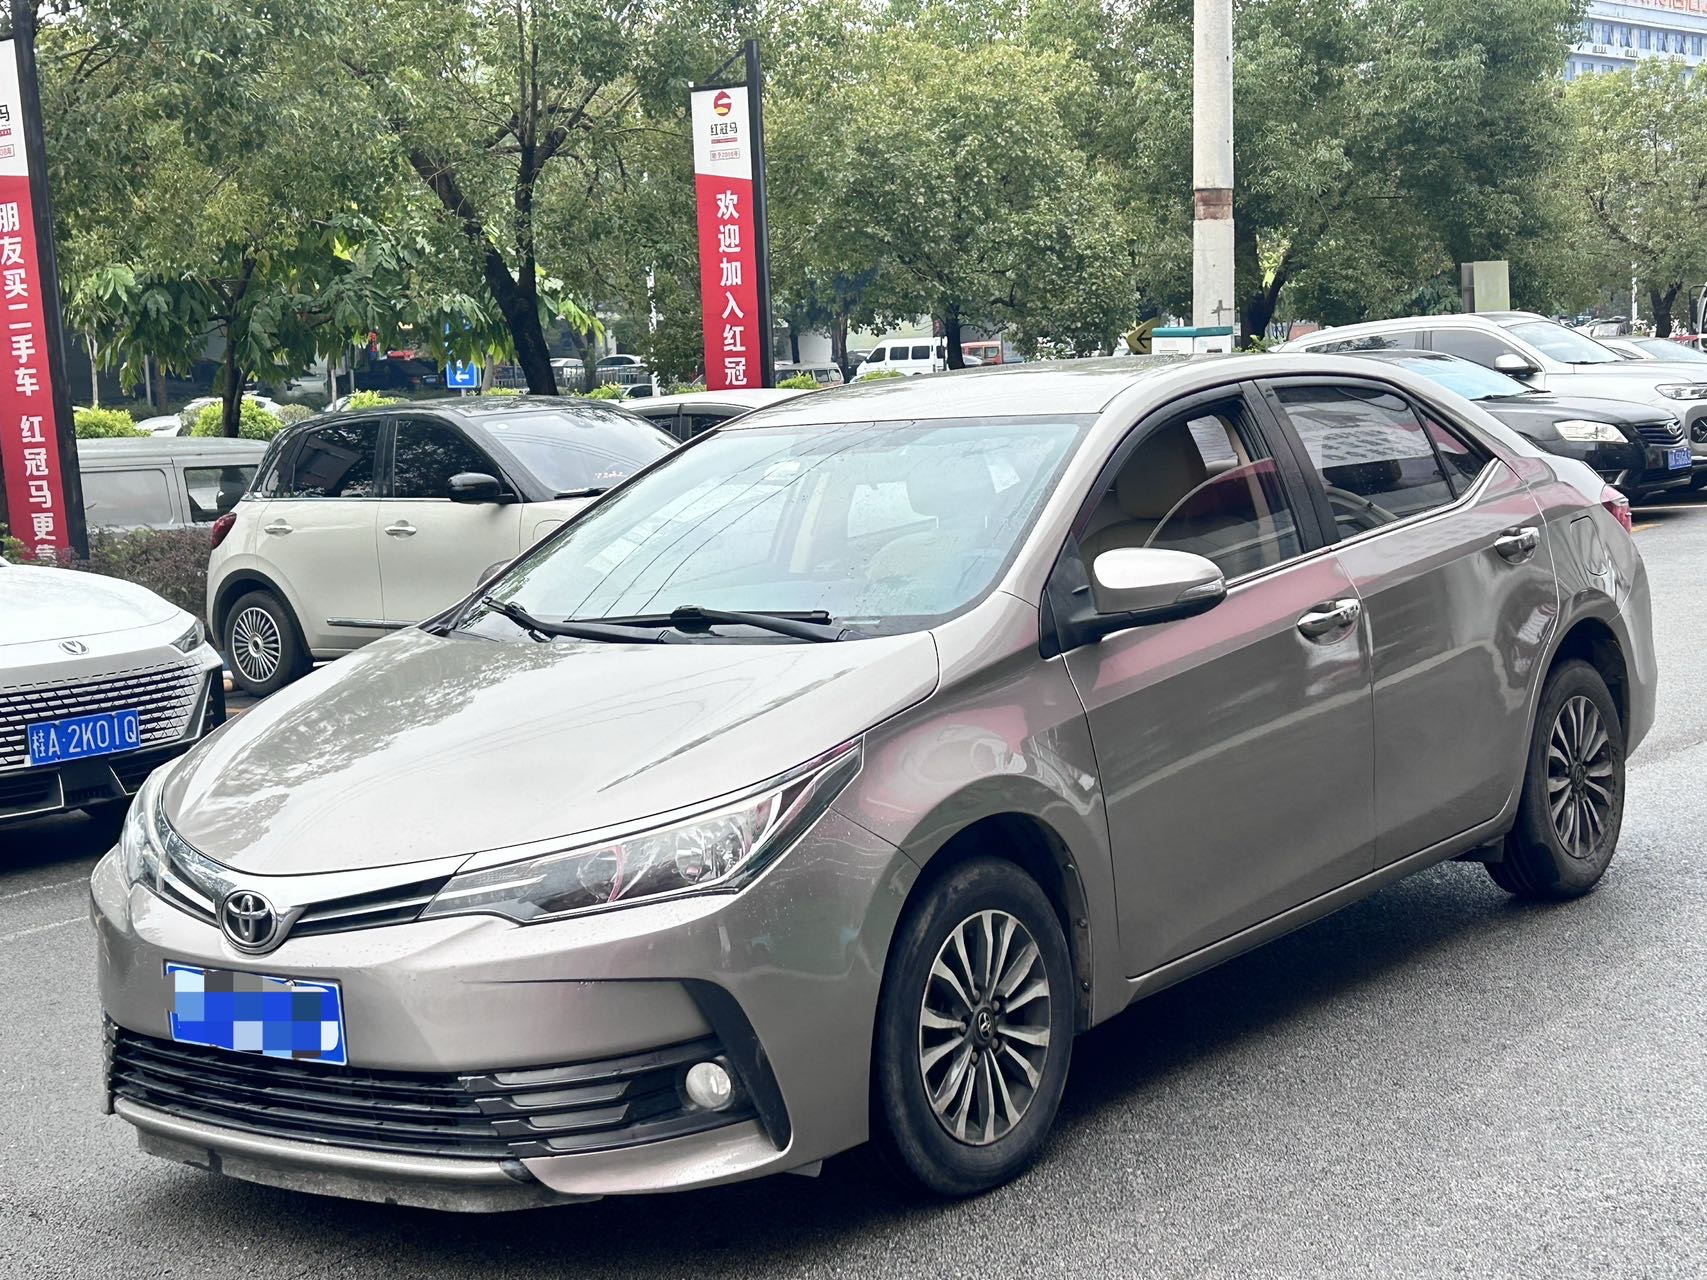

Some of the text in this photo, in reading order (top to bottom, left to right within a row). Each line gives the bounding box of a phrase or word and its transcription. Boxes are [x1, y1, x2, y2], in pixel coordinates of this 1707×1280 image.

[710, 122, 738, 136] 红冠马
[0, 202, 40, 396] 朋友买二手车
[716, 190, 747, 386] 欢迎加入红冠
